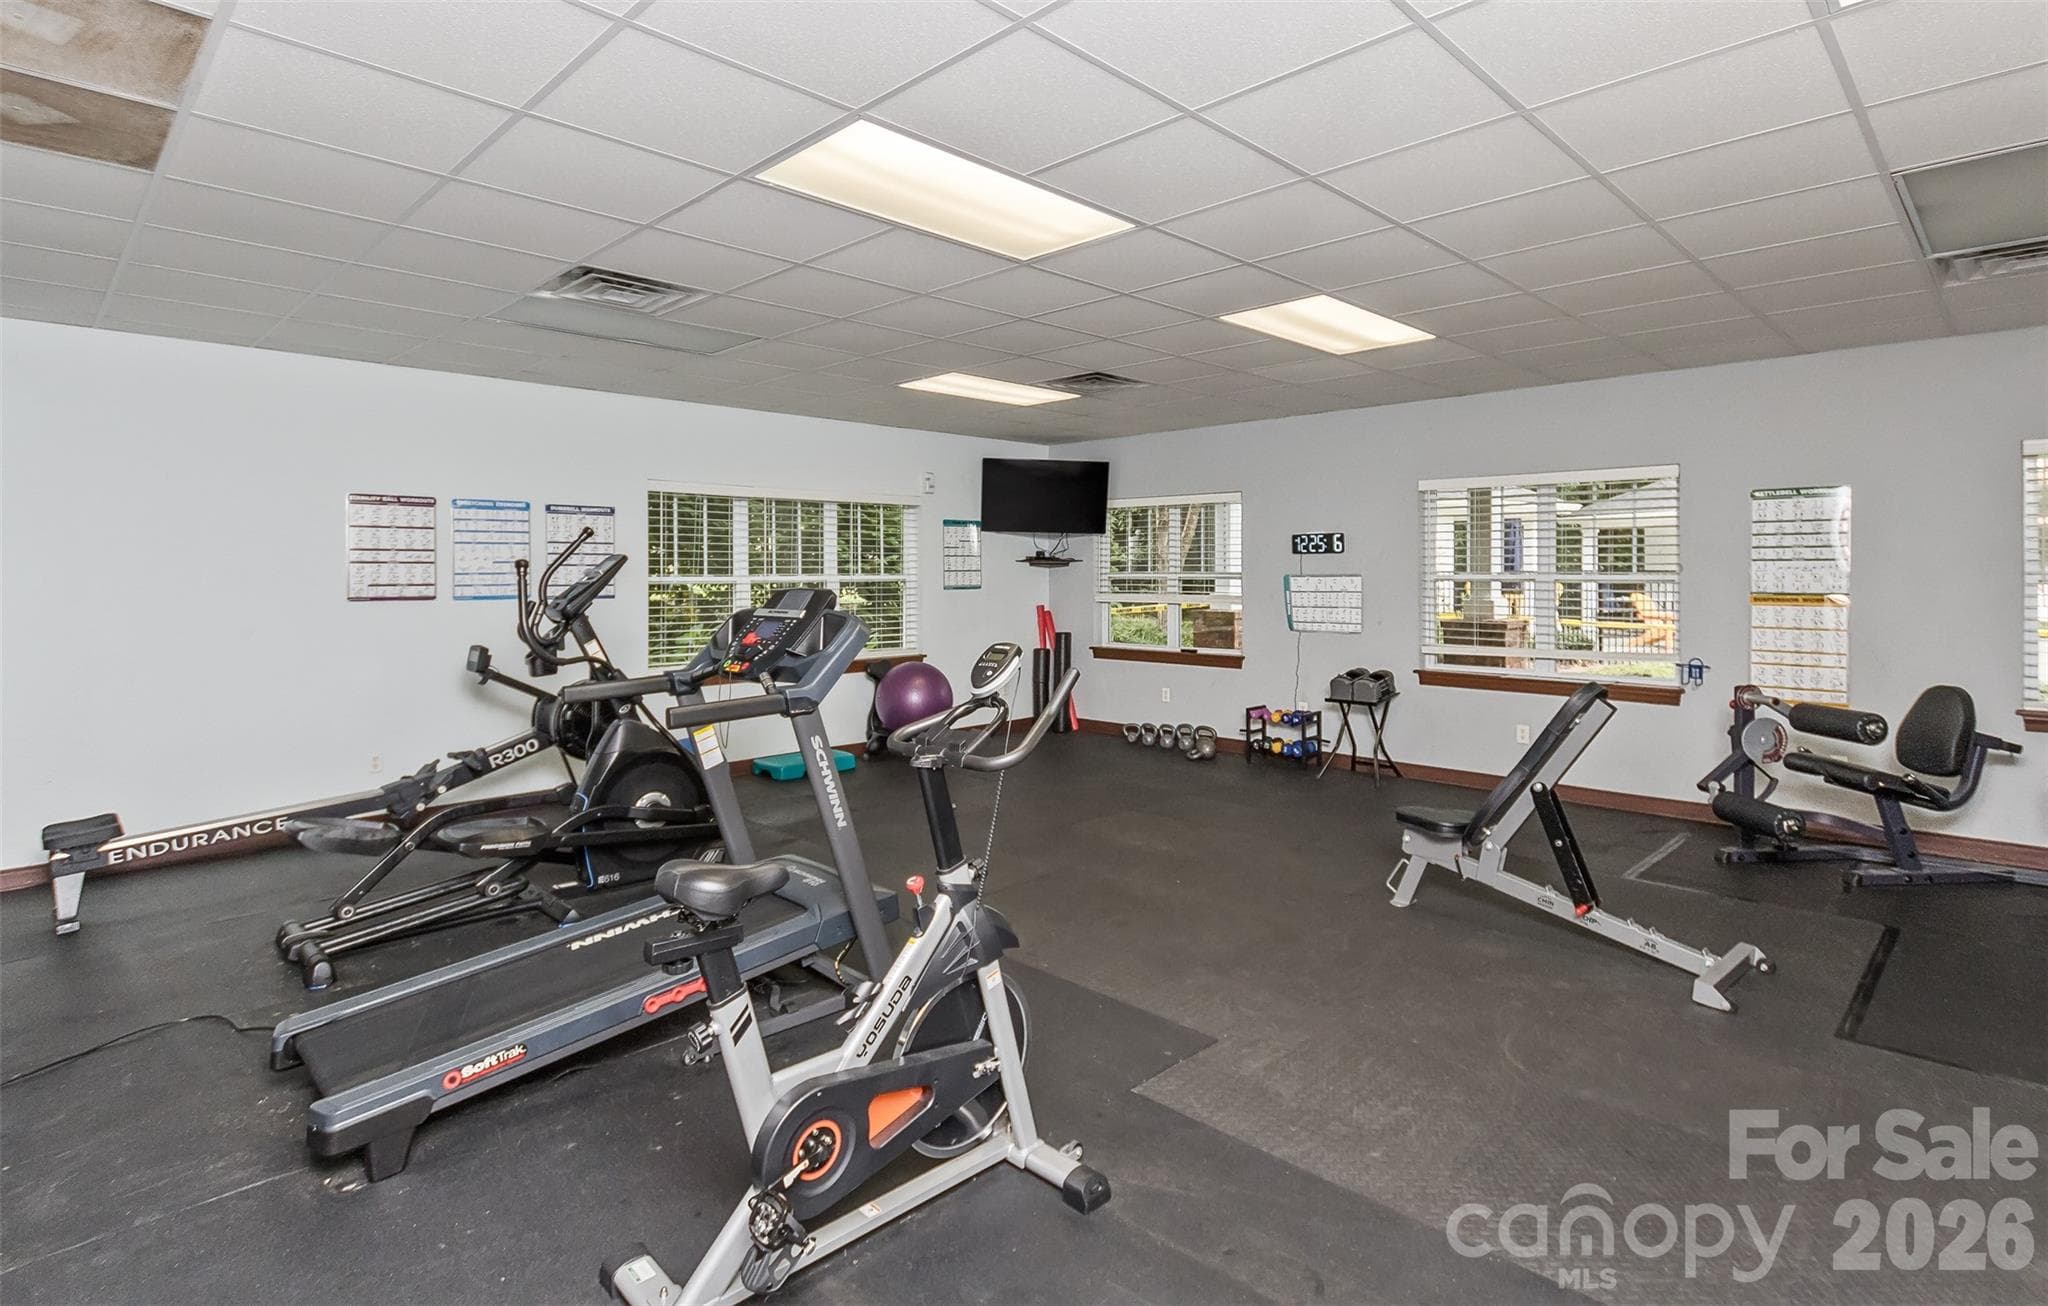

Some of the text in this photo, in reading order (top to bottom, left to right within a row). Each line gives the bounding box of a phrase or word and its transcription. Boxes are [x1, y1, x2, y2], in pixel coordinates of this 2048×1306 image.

[488, 738, 539, 769] R300
[810, 734, 848, 828] SCHWINN
[107, 816, 289, 865] ENDURANCE
[856, 974, 912, 1058] YOSUDA
